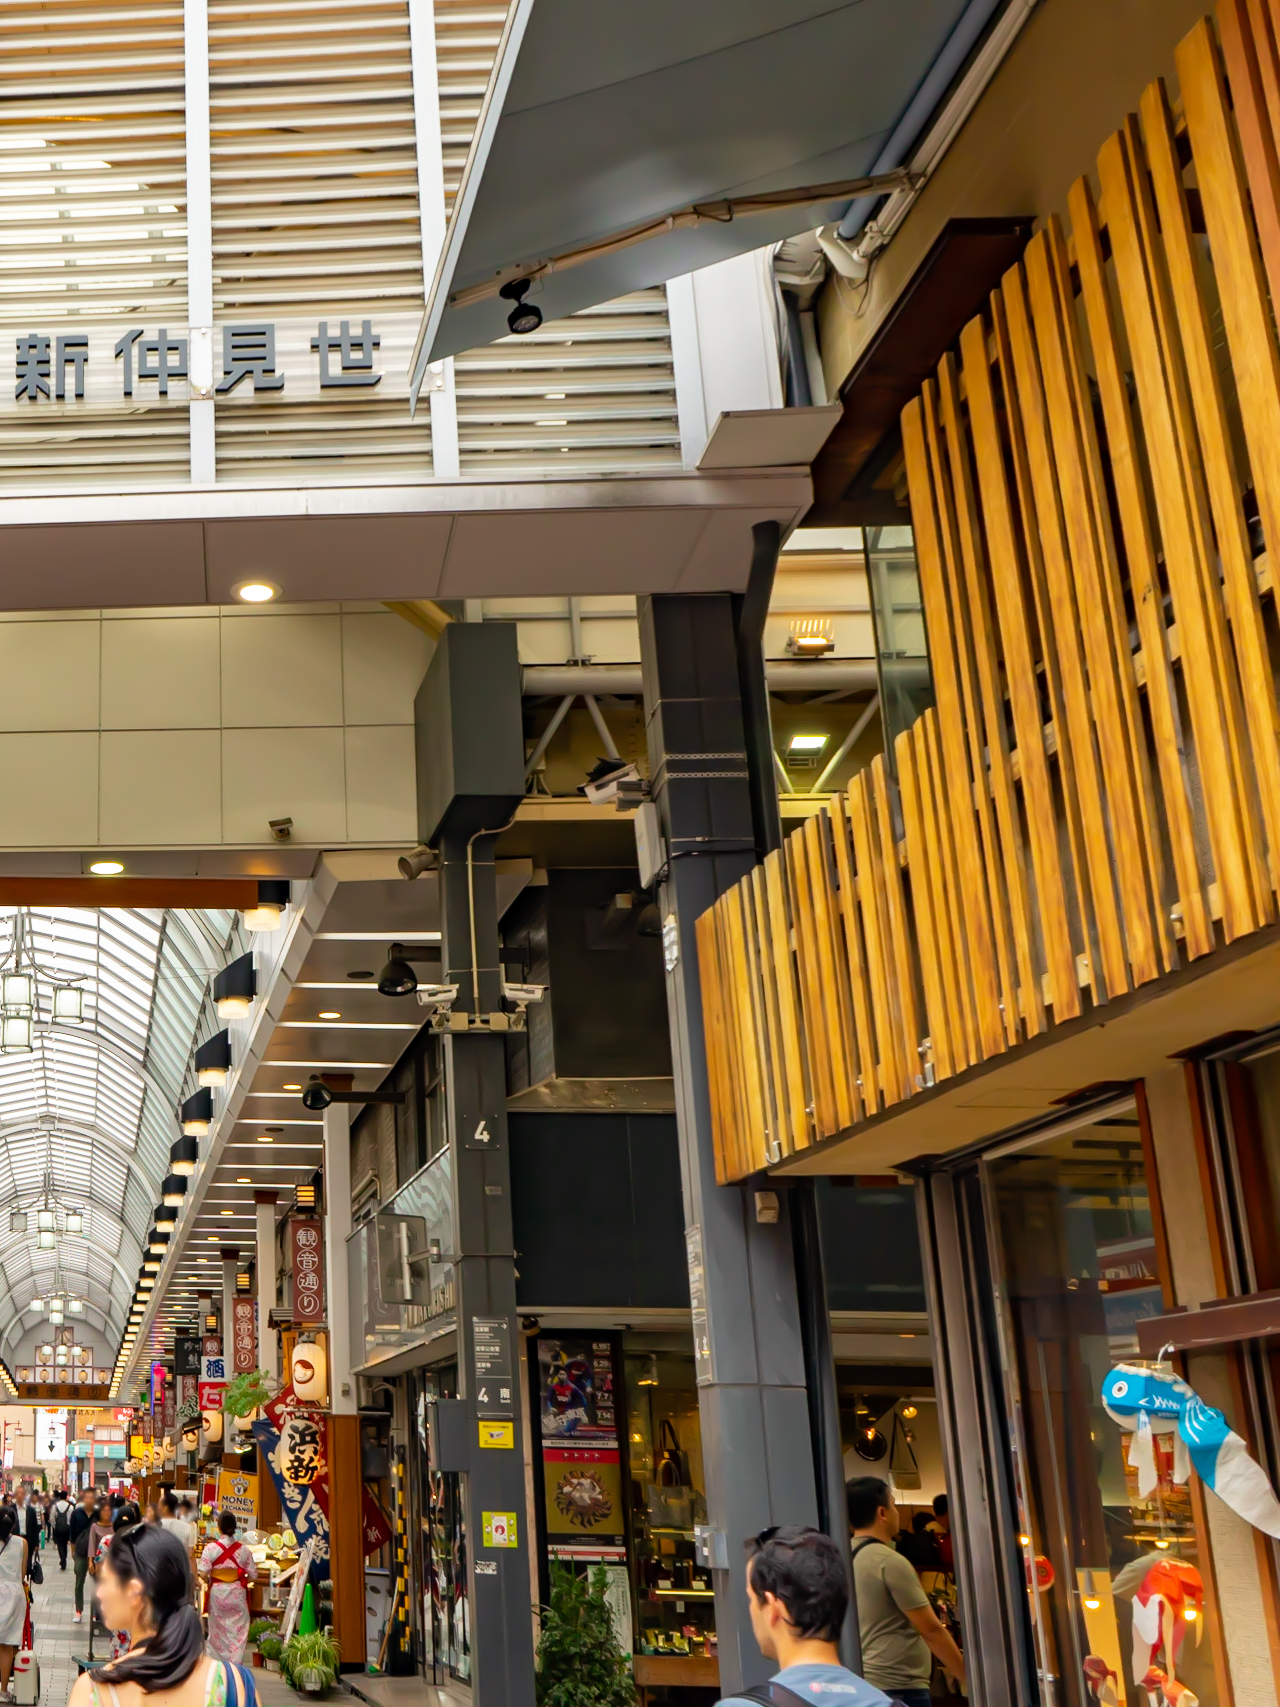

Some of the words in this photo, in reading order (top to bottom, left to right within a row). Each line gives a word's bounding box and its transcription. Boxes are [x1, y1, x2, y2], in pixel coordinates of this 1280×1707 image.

[15, 320, 386, 399] 新仲見世
[474, 1120, 490, 1142] 4
[296, 1227, 320, 1316] 観音通り
[235, 1303, 253, 1368] 観音通り
[206, 1358, 225, 1378] 酒
[477, 1387, 489, 1403] 4
[286, 1423, 320, 1482] 浜新
[221, 1495, 255, 1507] MONEY
[221, 1504, 254, 1514] EXCHANGE
